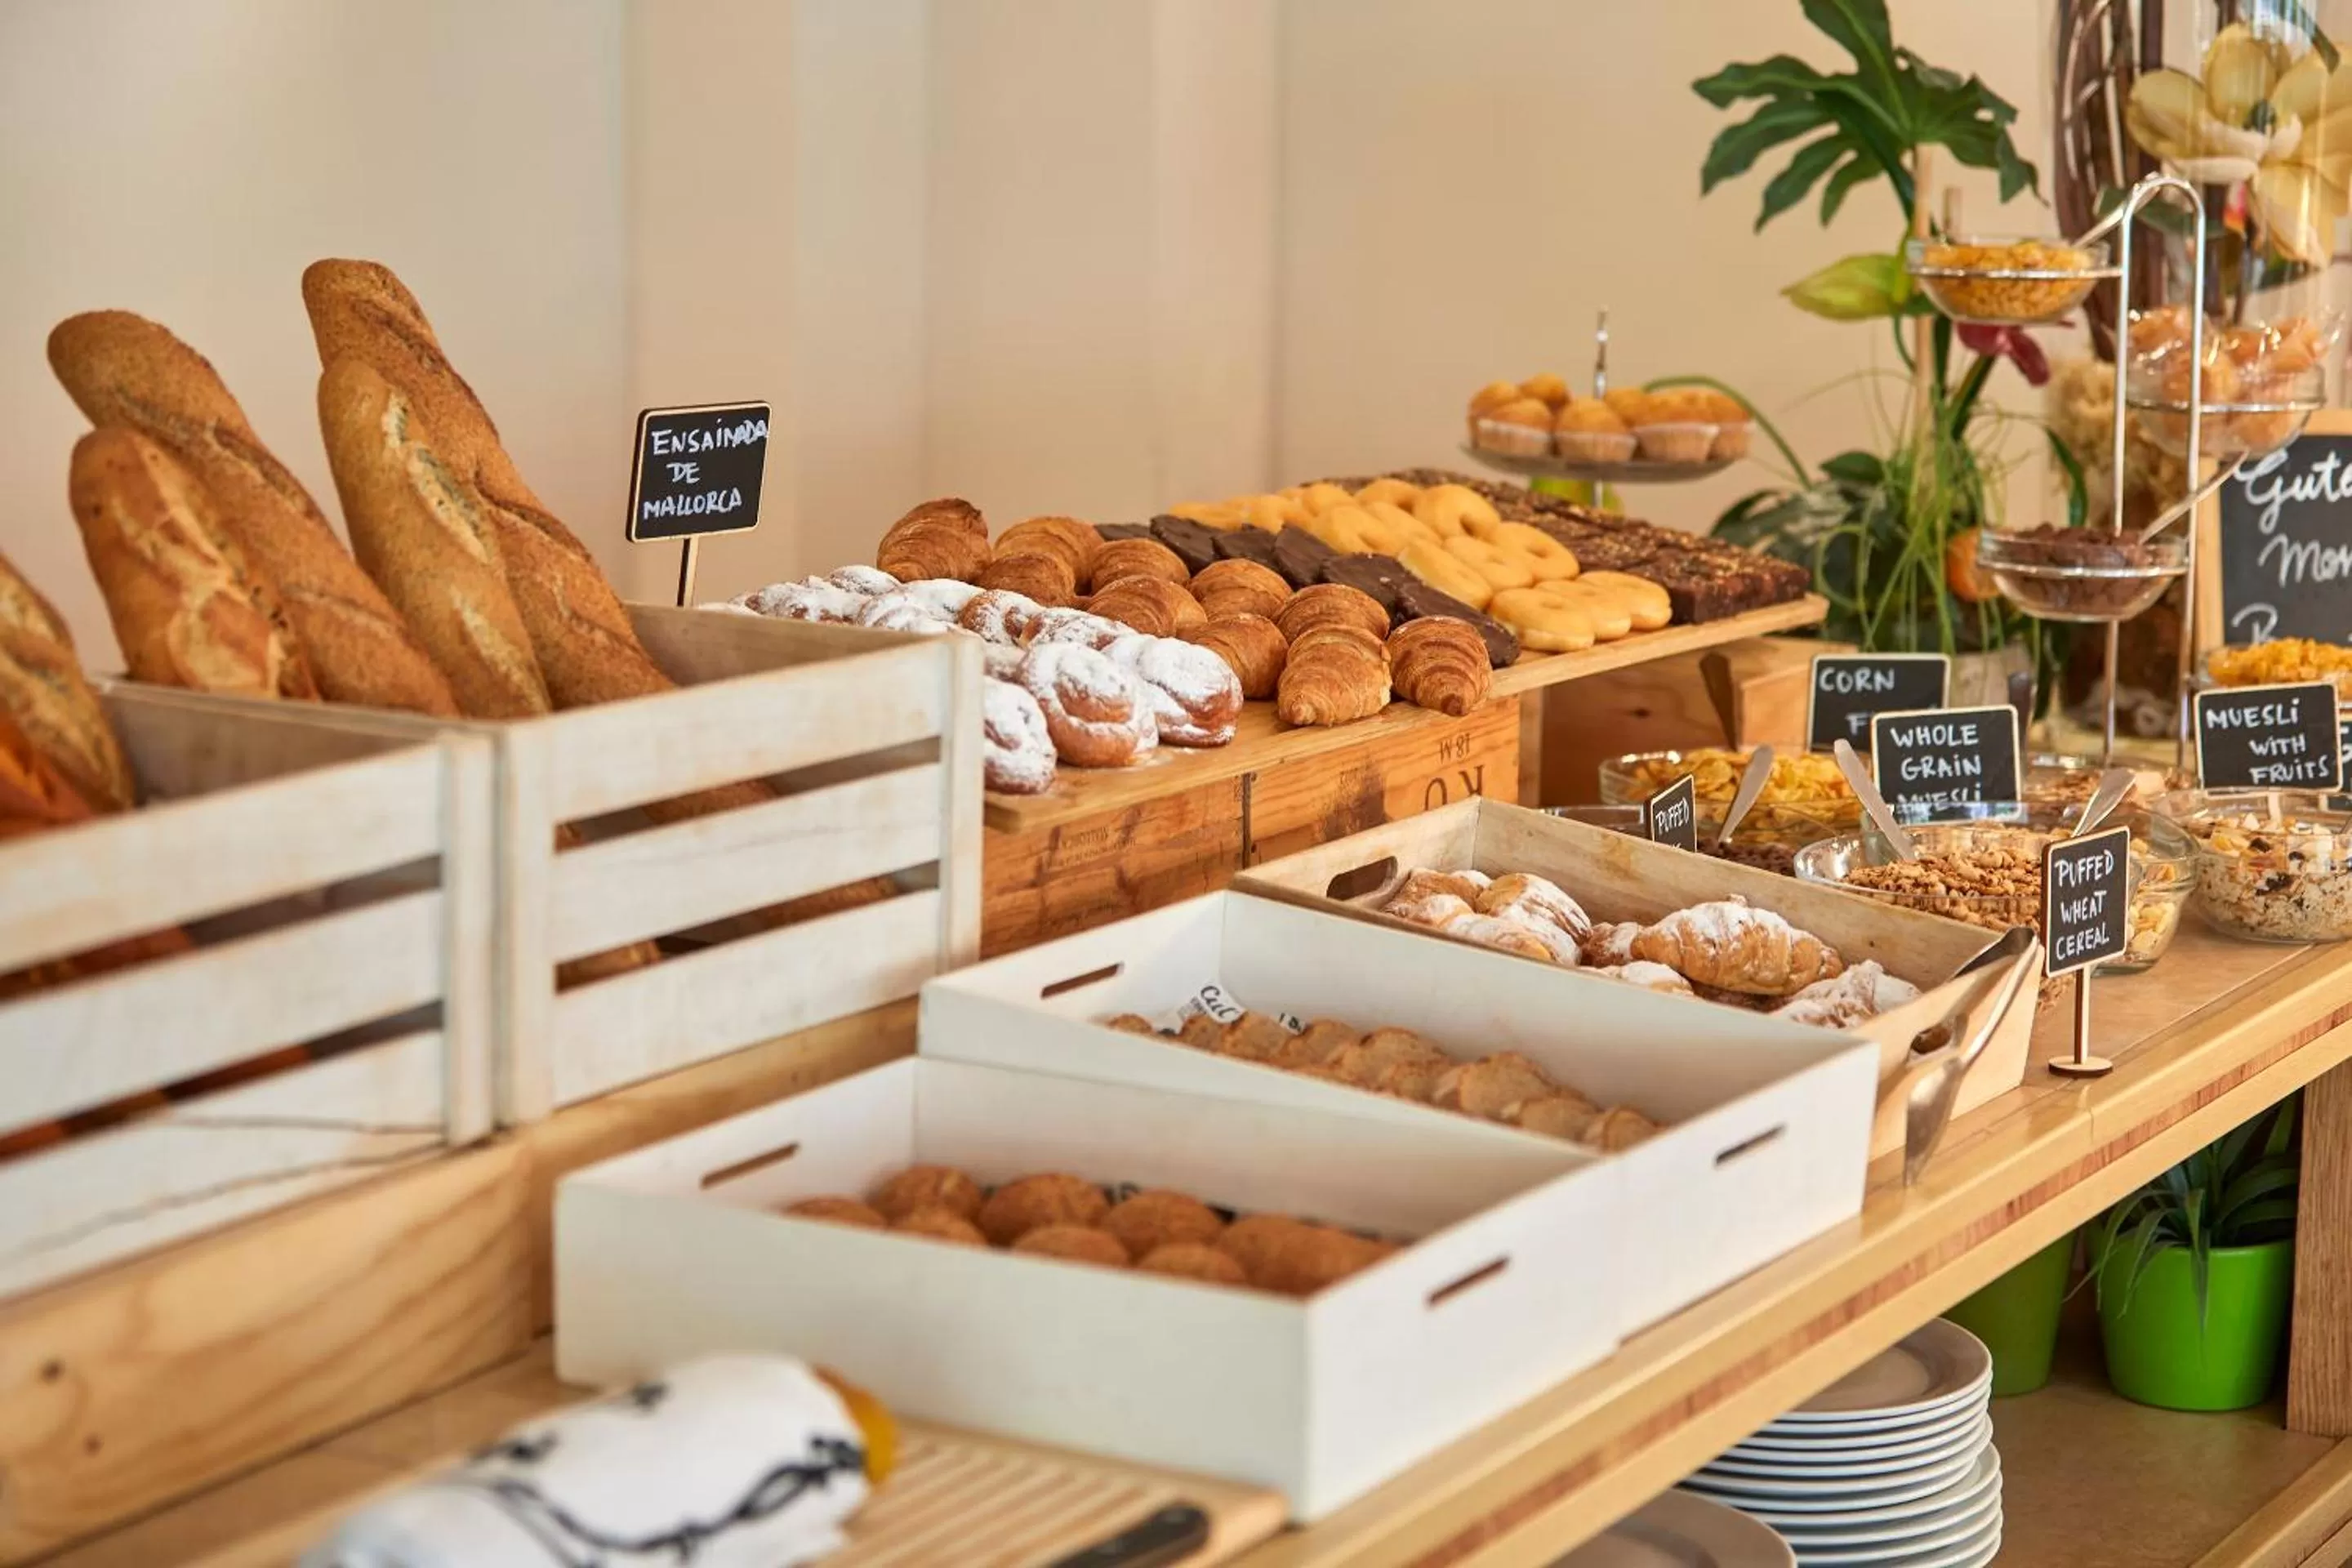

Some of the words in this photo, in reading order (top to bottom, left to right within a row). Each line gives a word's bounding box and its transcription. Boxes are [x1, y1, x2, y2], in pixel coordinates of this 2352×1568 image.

[666, 462, 700, 483] DE
[643, 488, 742, 519] MALLORCA
[1819, 666, 1895, 693] CORN
[2206, 697, 2300, 729] MUESLI
[1890, 724, 1979, 747] WHOLE
[2248, 733, 2306, 757] WITH
[1900, 754, 1982, 782] GRAIN
[2248, 755, 2329, 784] FRUITS
[2054, 849, 2114, 887] PUFFED
[2060, 890, 2107, 924] WHEAT
[2056, 921, 2109, 960] CEREAL
